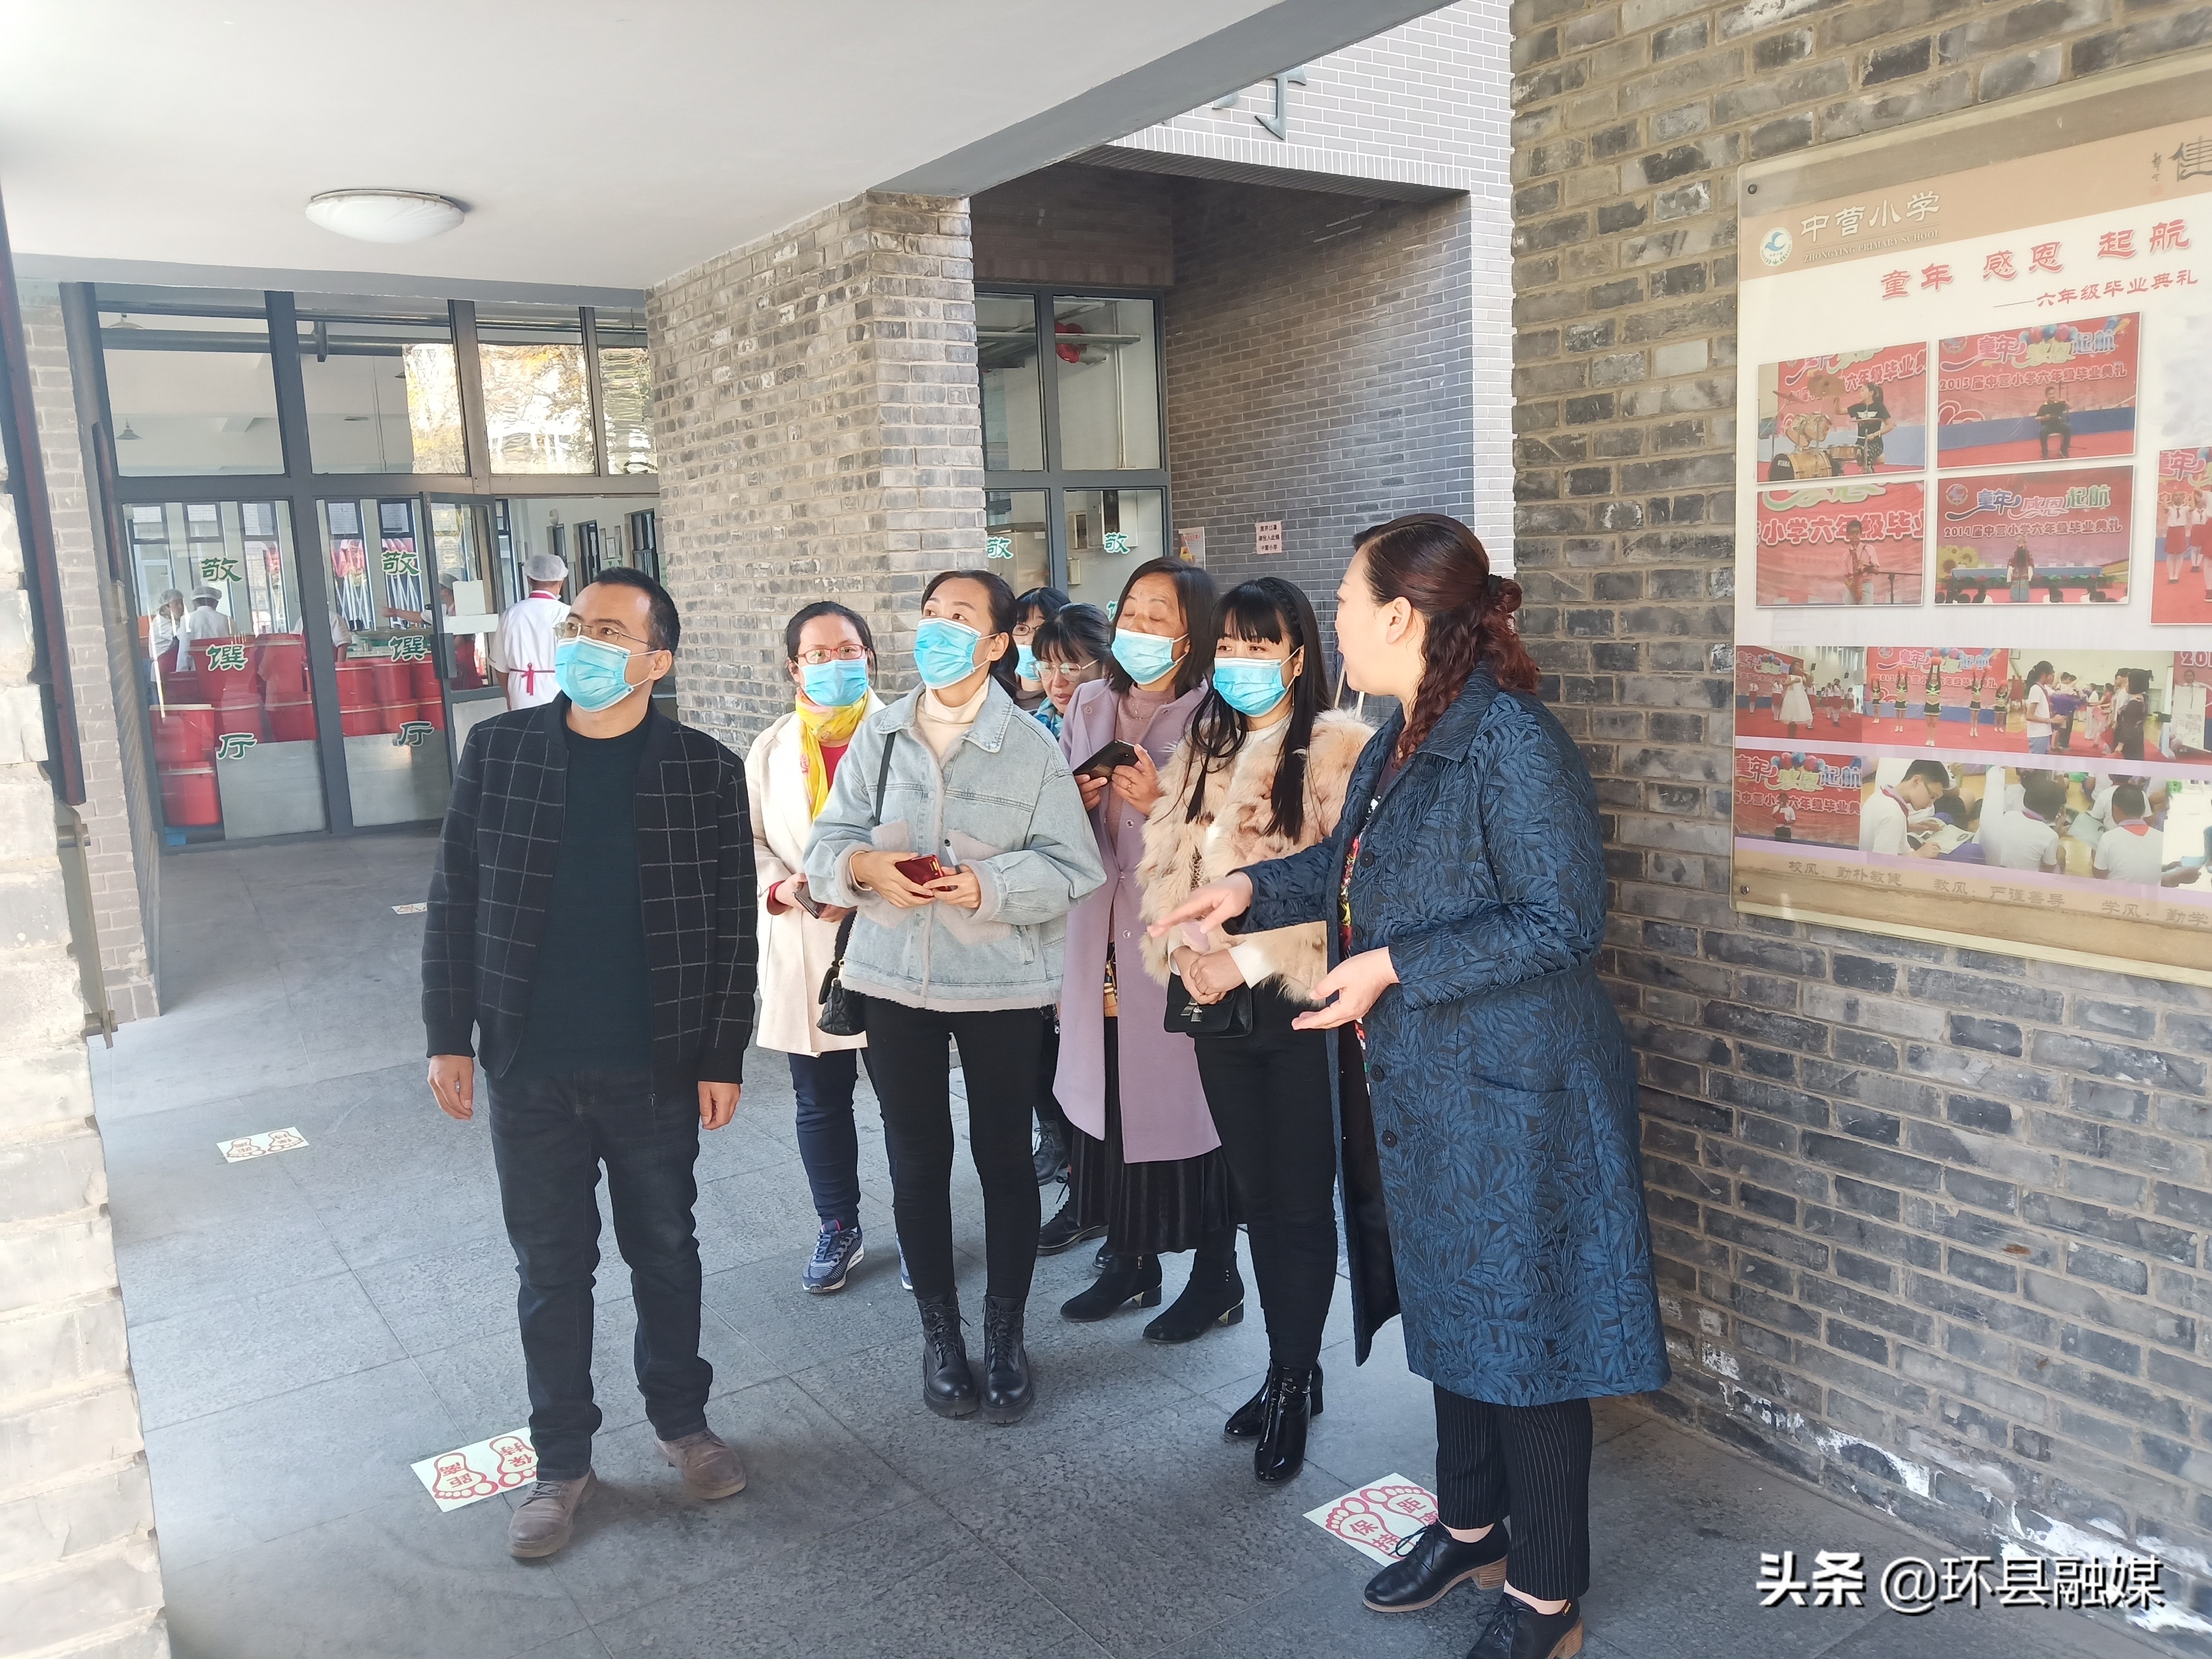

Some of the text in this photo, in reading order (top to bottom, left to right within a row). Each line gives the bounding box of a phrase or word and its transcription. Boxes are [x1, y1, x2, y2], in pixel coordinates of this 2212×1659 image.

[1801, 191, 1940, 242] 中营小学
[1803, 230, 1940, 264] ZHONGYING PRIMARY SCHOOL
[1881, 218, 2190, 300] 童年 感恩 起航
[1945, 484, 2111, 521] 童年感恩起航
[500, 1442, 532, 1467] 保持
[439, 1462, 473, 1488] 距离
